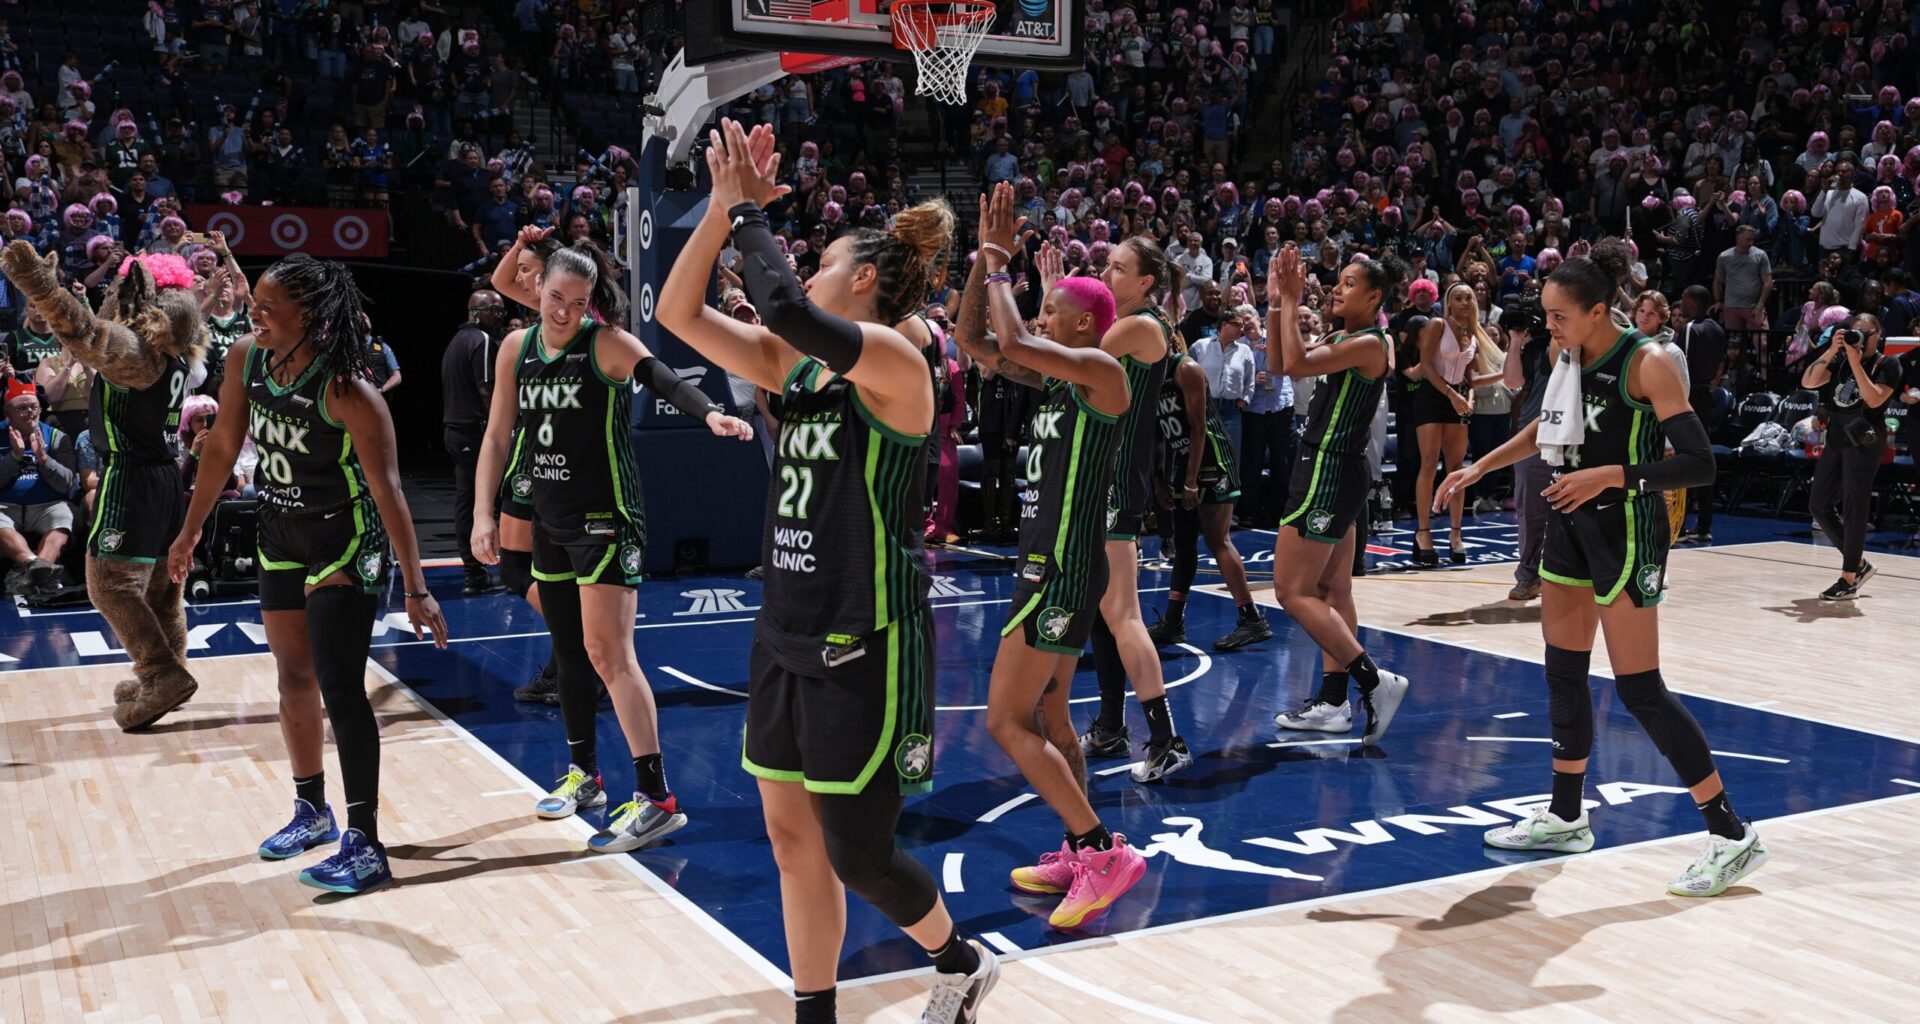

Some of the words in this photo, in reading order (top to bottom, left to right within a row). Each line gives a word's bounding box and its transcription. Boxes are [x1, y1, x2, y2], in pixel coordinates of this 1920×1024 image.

[1015, 20, 1052, 35] AT&T
[519, 384, 583, 410] LYNX
[1744, 404, 1773, 413] WNBA
[1784, 401, 1813, 411] WNBA
[1884, 407, 1908, 416] WNB
[537, 413, 553, 447] 6
[1160, 416, 1182, 439] 00
[778, 421, 841, 460] YNX
[256, 444, 293, 485] 20
[534, 453, 567, 466] MAYO
[532, 466, 571, 481] CLINIC
[778, 465, 813, 519] 21
[774, 526, 813, 549] MAYO
